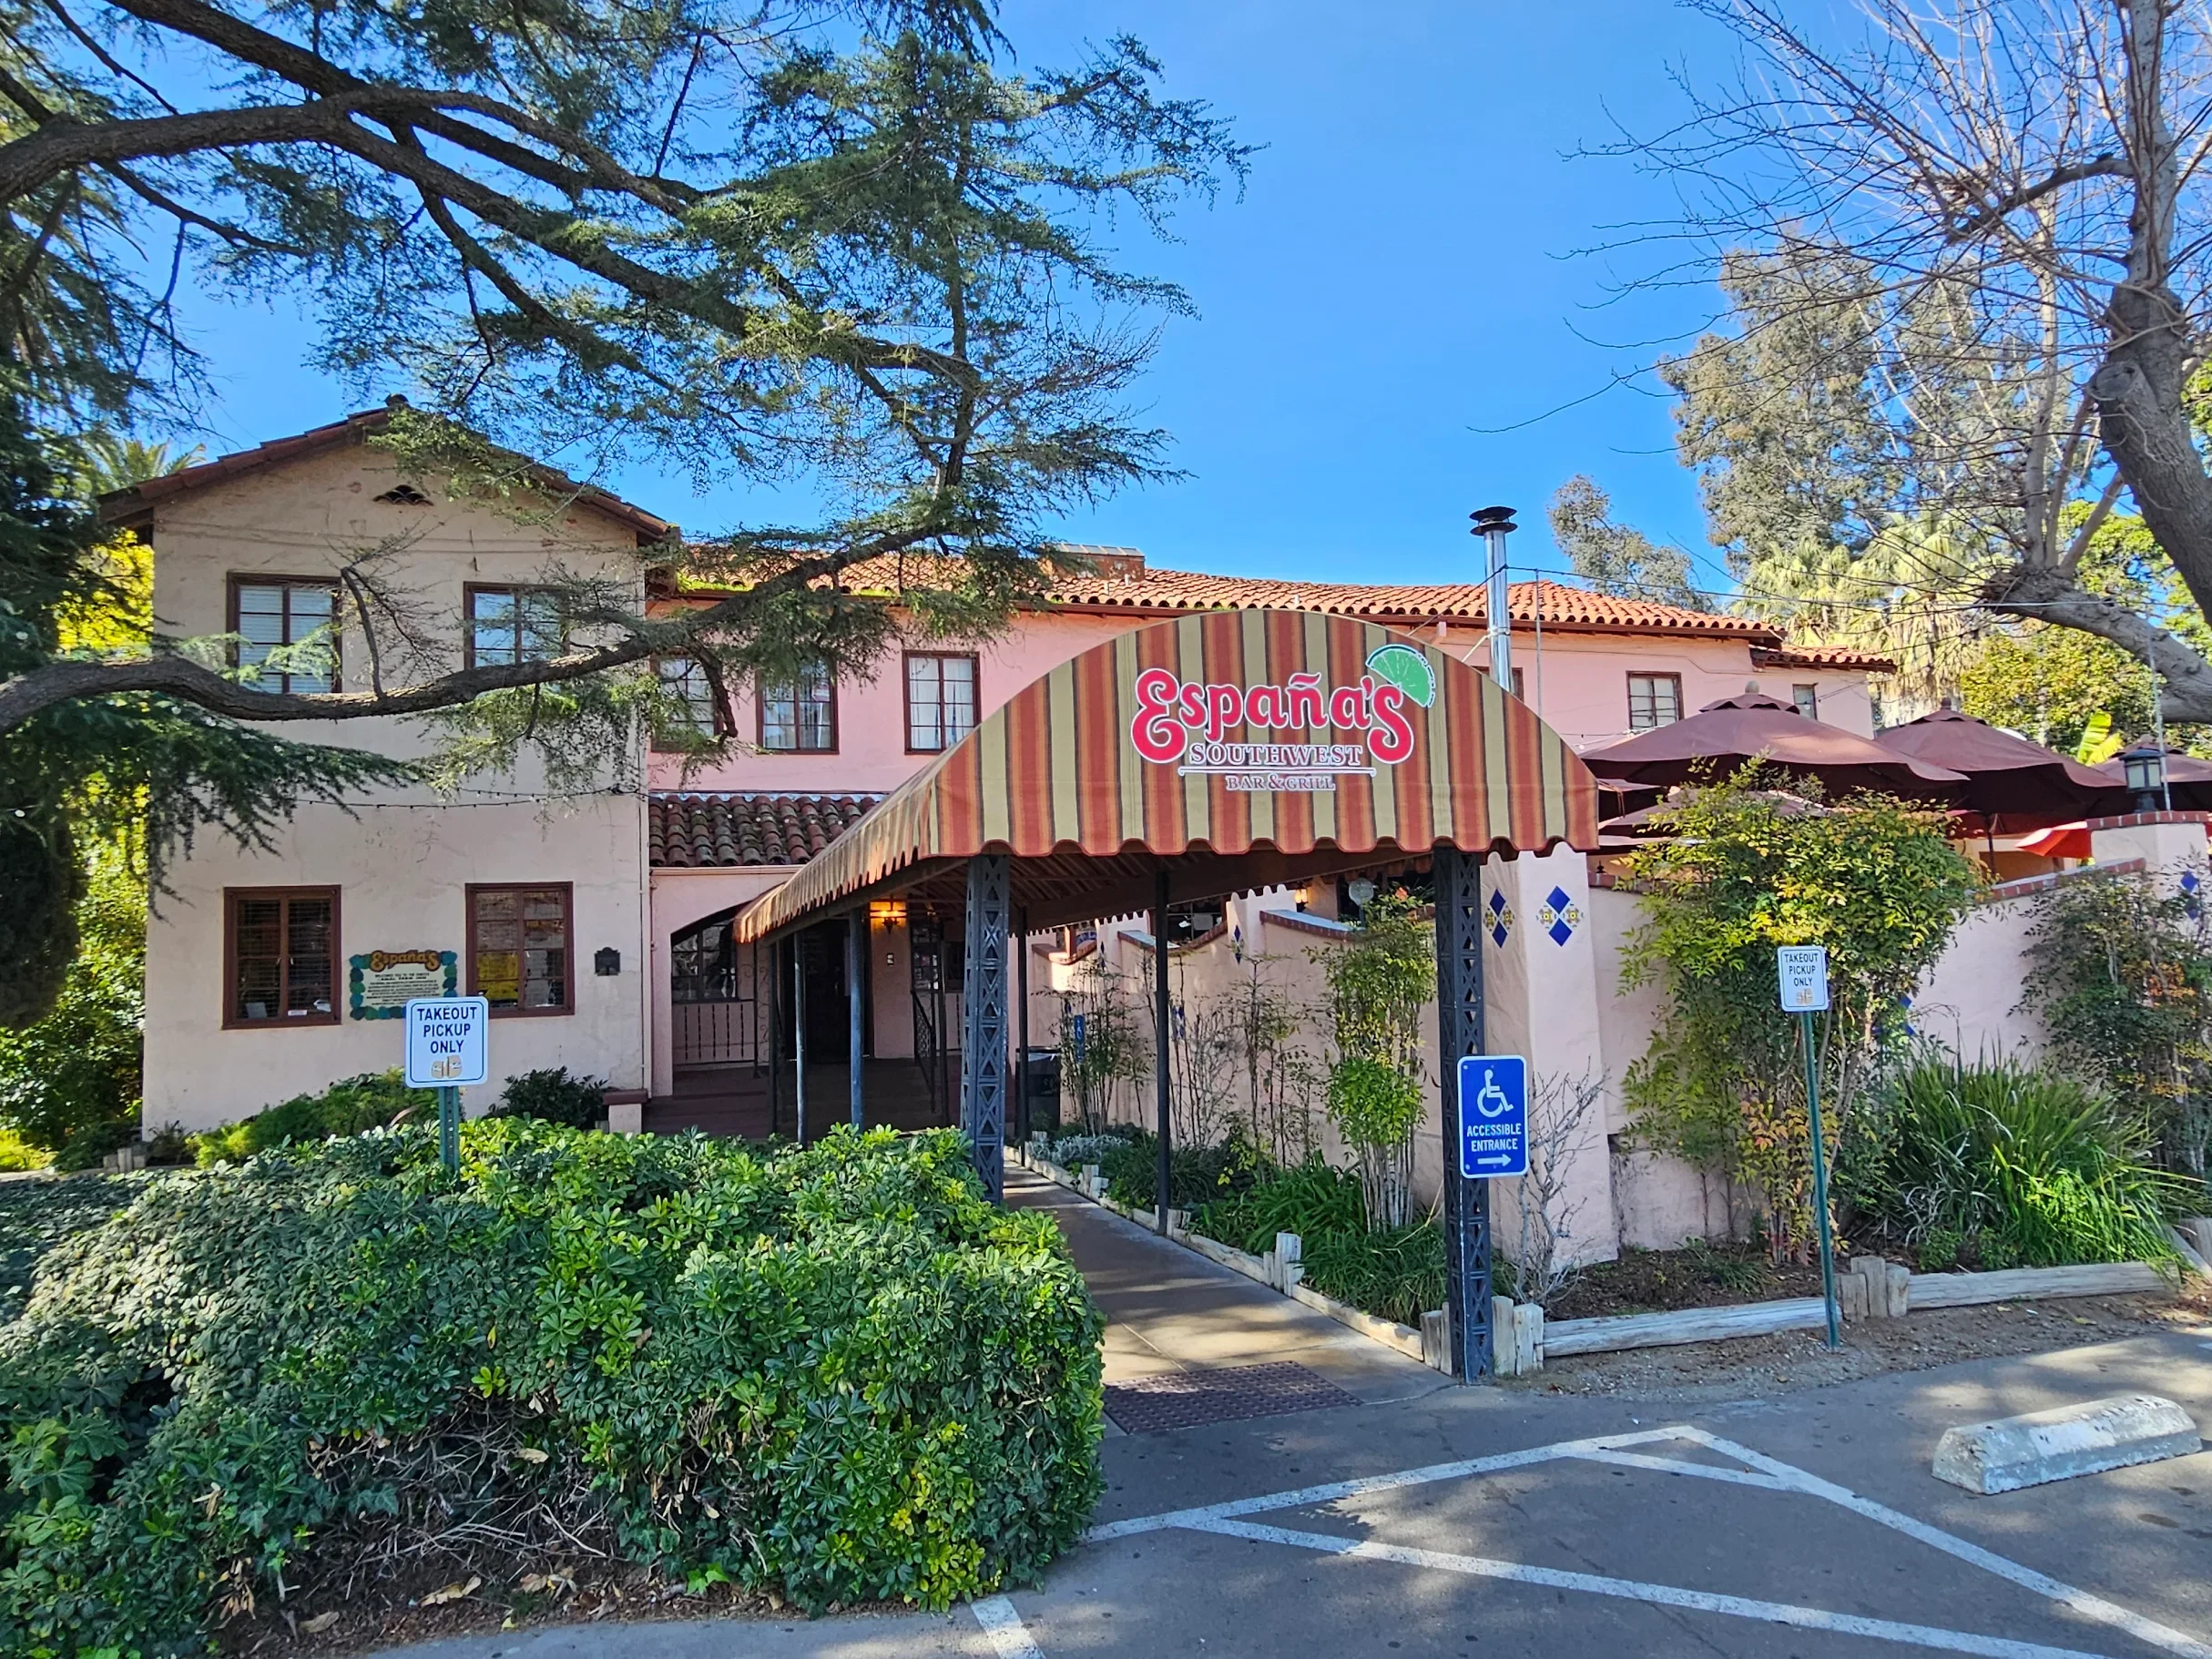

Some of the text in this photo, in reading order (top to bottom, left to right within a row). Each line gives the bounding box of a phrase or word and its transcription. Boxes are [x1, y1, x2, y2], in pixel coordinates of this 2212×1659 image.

[1189, 743, 1362, 766] SOUTHWEST
[1226, 774, 1336, 790] BAR & GRILL
[1785, 953, 1819, 962] TAKEOUT
[1789, 965, 1816, 974] PICKUP
[1793, 977, 1813, 986] ONLY
[417, 1007, 477, 1021] TAKEOUT
[423, 1023, 471, 1037] PICKUP
[430, 1040, 464, 1053] ONLY
[1467, 1123, 1522, 1137] ACCESSIBLE
[1471, 1138, 1518, 1152] ENTRANCE
